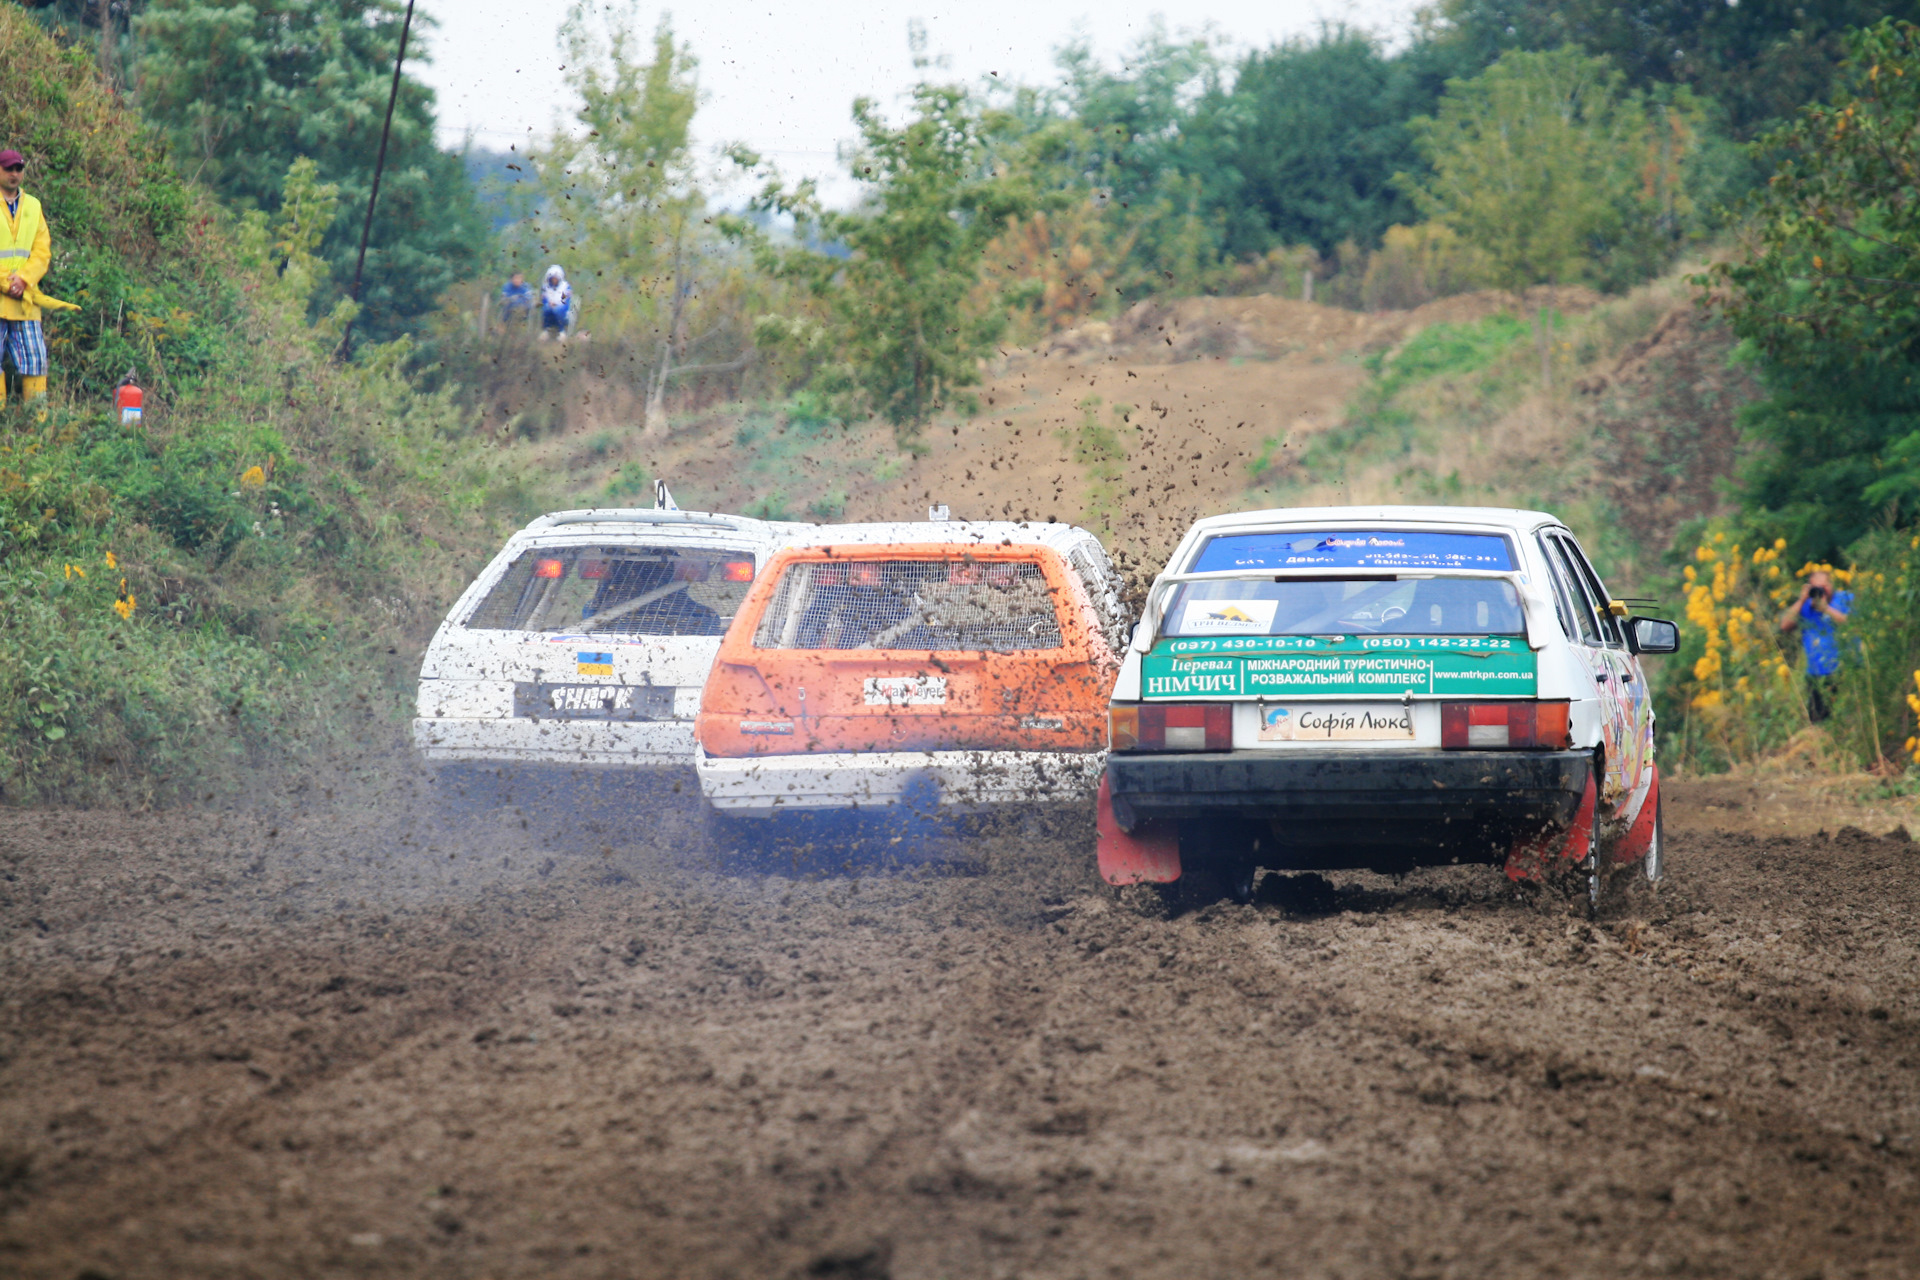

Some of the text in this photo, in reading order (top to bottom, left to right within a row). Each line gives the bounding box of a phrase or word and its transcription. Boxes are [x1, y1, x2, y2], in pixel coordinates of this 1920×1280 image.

[1170, 639, 1316, 652] (097) 430-10-10
[1362, 638, 1511, 648] (050) 142-22-22
[1171, 659, 1233, 674] Перевал
[1247, 657, 1431, 671] МІЖНАРОДНИЙ ТУРИСТИЧНО-
[1251, 672, 1426, 685] РОЗВАЖАЛЬНИЙ КОМПЛЕКС
[1434, 670, 1534, 681] www.mtrkpn.com.ua
[1148, 674, 1236, 693] НІМЧИЧ
[1299, 711, 1355, 738] Софія
